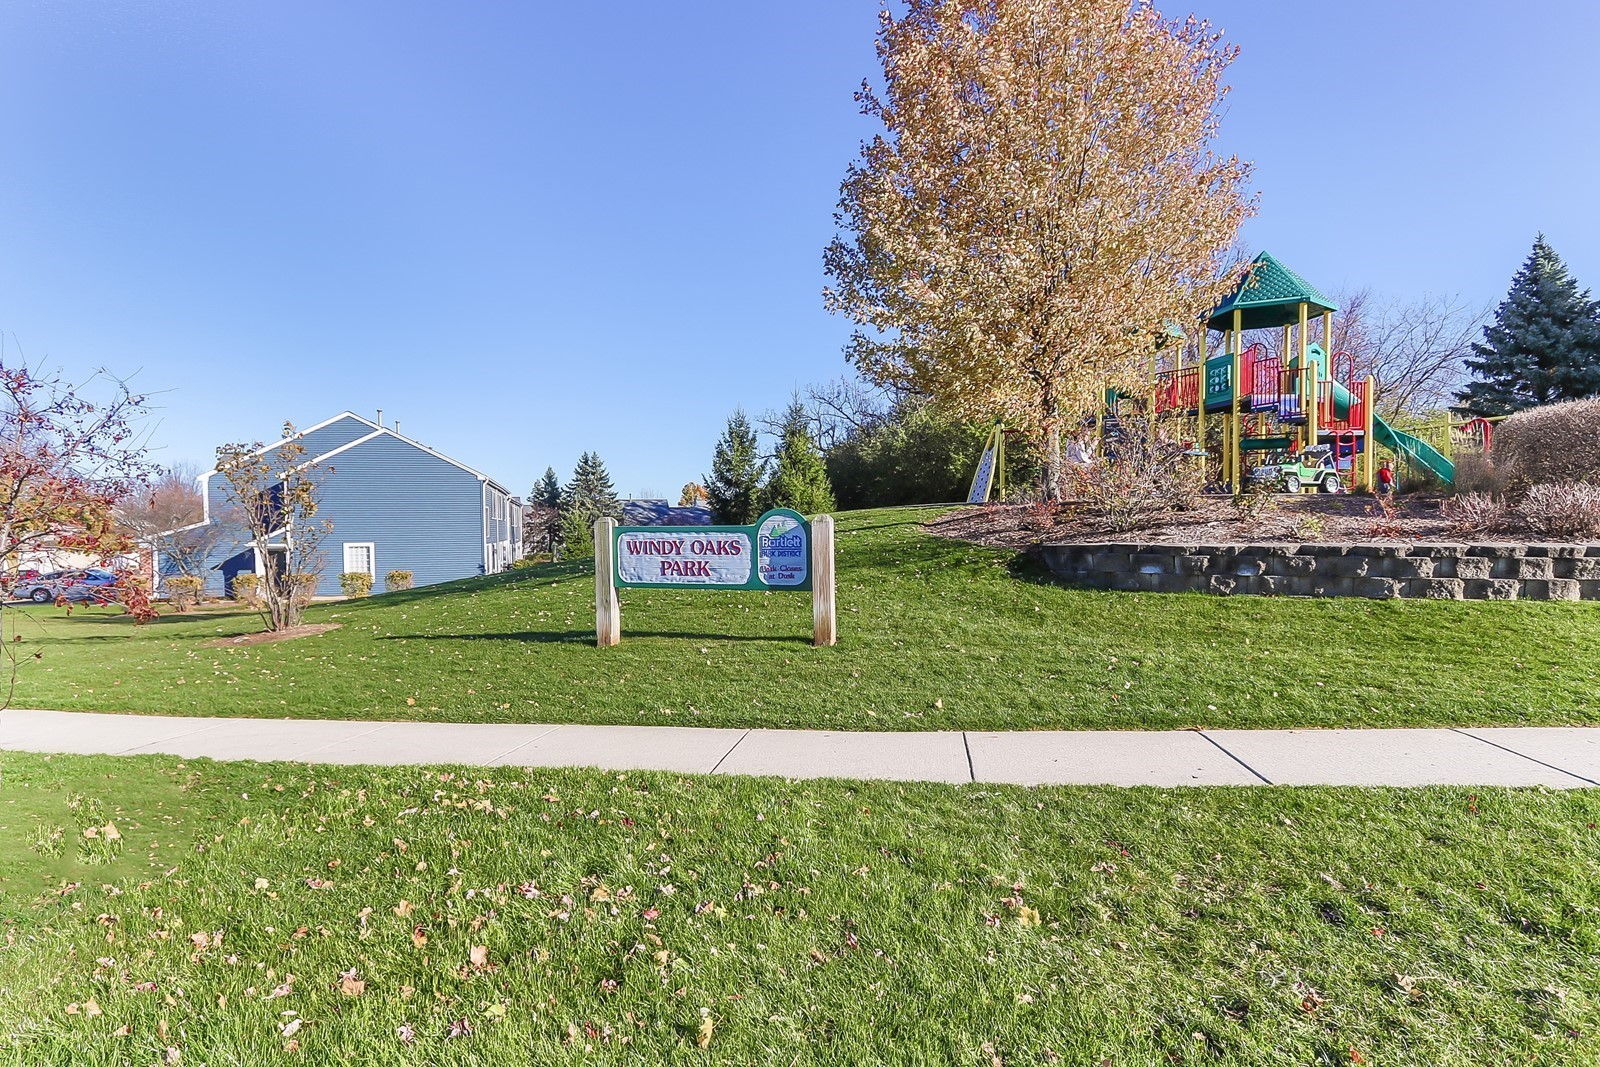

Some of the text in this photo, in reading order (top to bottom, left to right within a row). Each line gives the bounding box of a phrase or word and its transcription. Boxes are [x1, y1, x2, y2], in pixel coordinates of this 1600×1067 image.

[626, 539, 742, 556] WINDY OAKS
[761, 535, 802, 548] Bartlett
[660, 560, 711, 577] PARK
